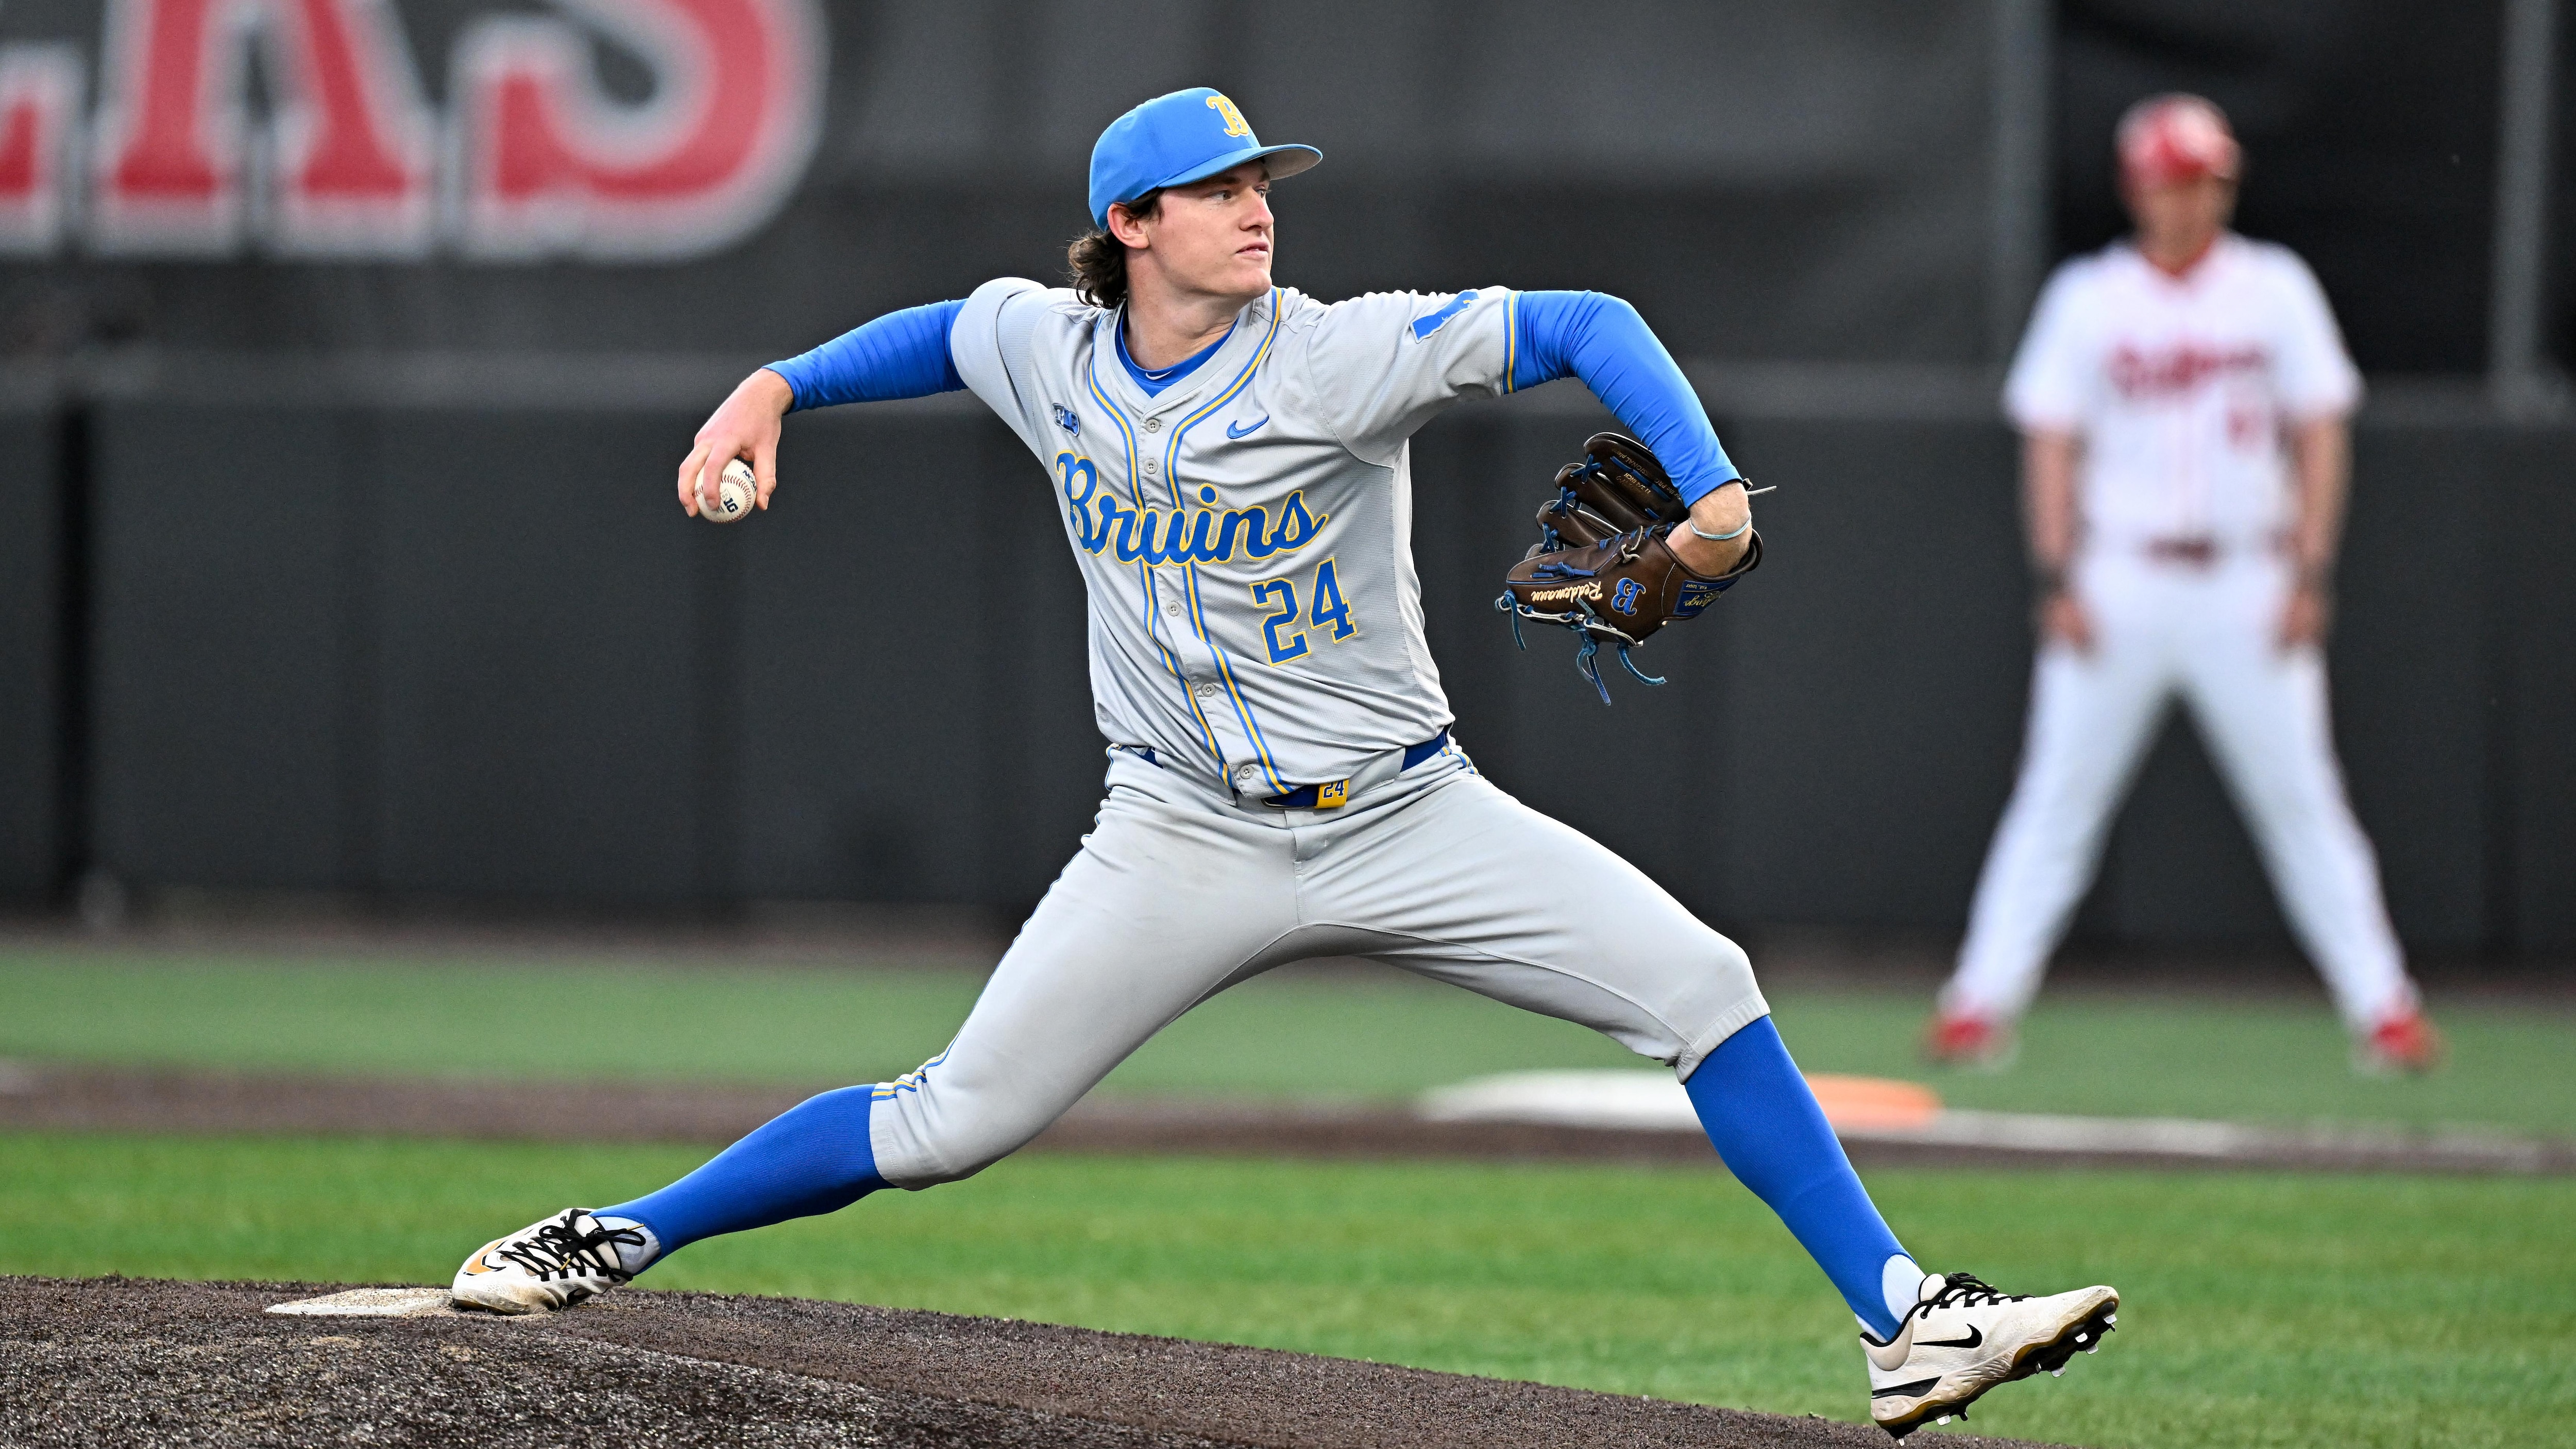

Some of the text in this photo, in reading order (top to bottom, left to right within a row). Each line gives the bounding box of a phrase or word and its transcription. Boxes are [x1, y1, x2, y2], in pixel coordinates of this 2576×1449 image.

[1206, 95, 1249, 138] B
[1623, 472, 1637, 484] INCH
[1055, 449, 1329, 569] Bruins
[1531, 581, 1603, 603] Reddemann
[1611, 577, 1646, 616] B
[1248, 557, 1358, 667] 24
[1323, 779, 1345, 798] 24
